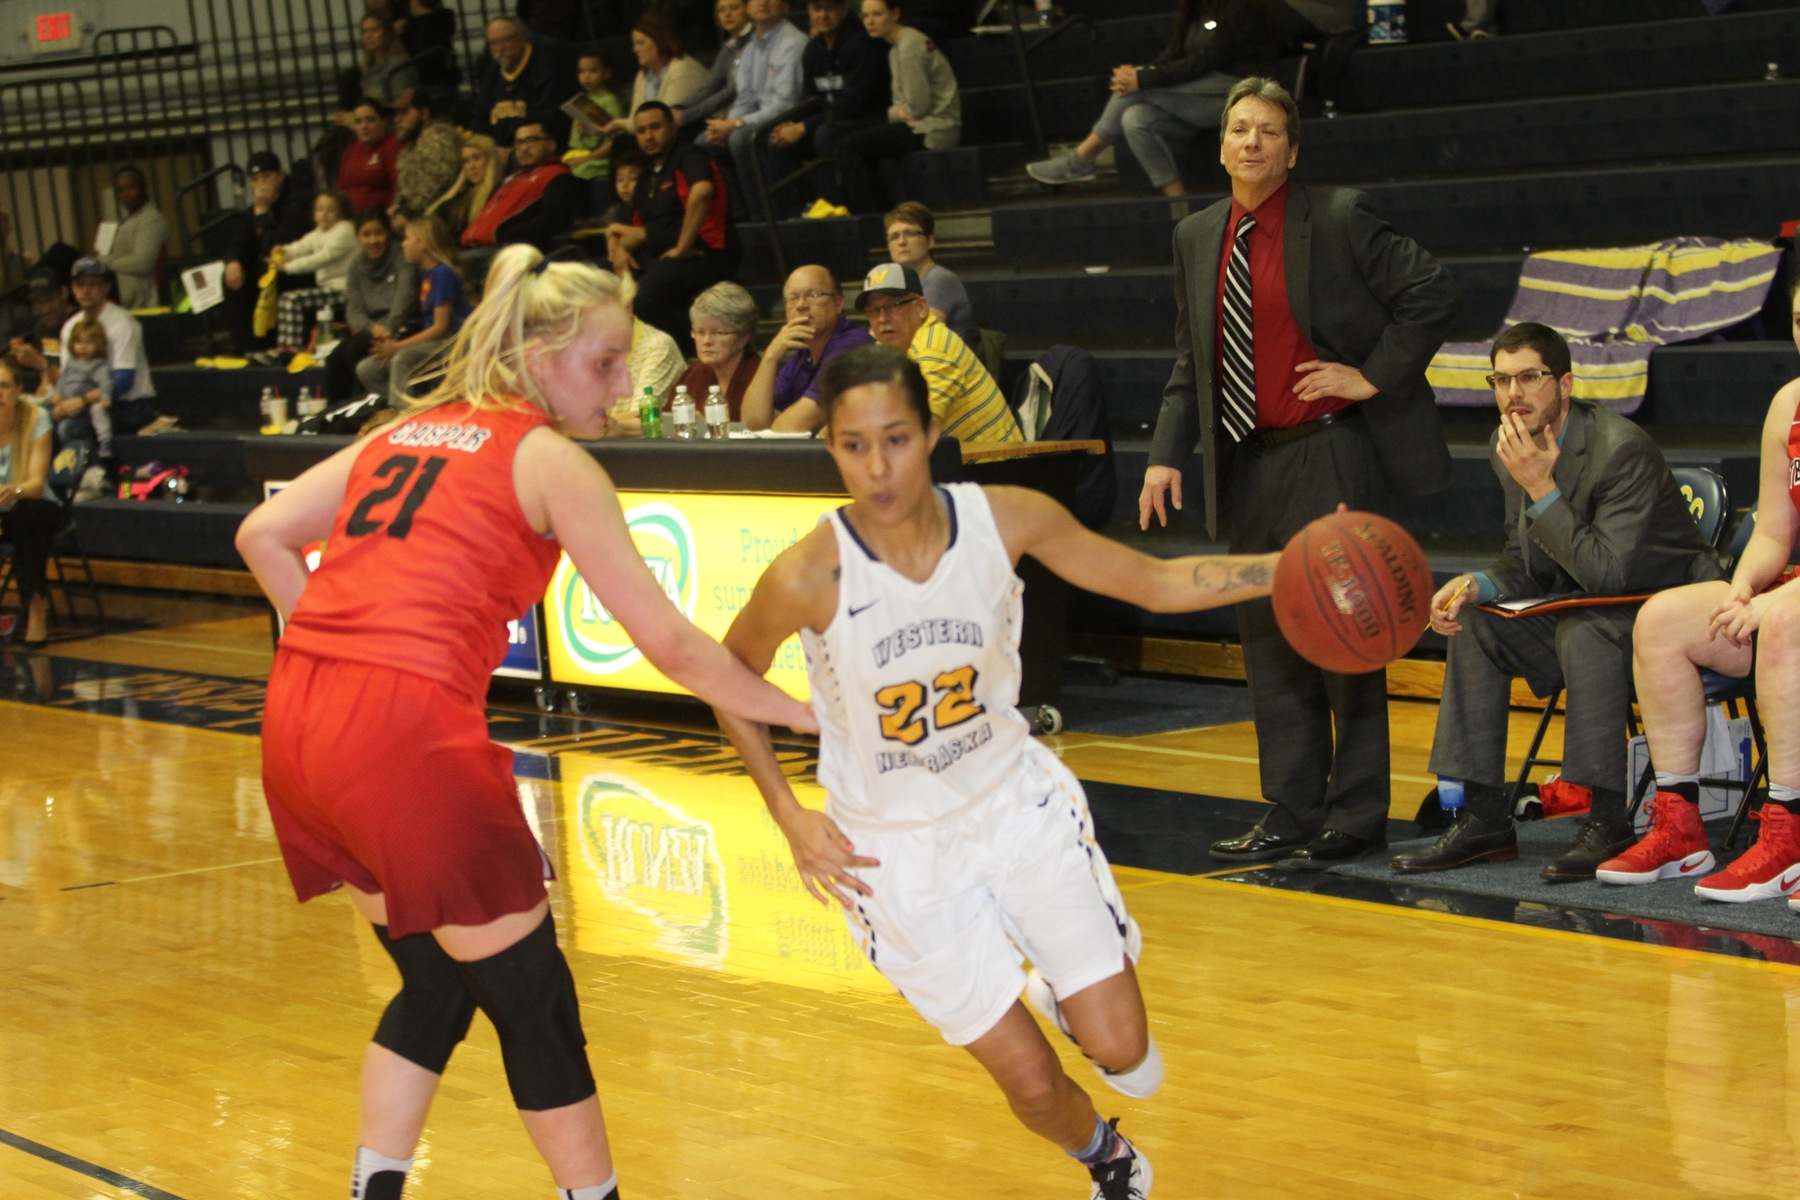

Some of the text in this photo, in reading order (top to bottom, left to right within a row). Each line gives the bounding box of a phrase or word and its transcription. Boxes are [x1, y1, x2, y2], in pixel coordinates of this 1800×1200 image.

[37, 13, 71, 42] EXIT
[389, 421, 491, 453] CASPER
[346, 454, 448, 541] 21
[871, 618, 984, 669] WESTERN
[874, 664, 987, 747] 22
